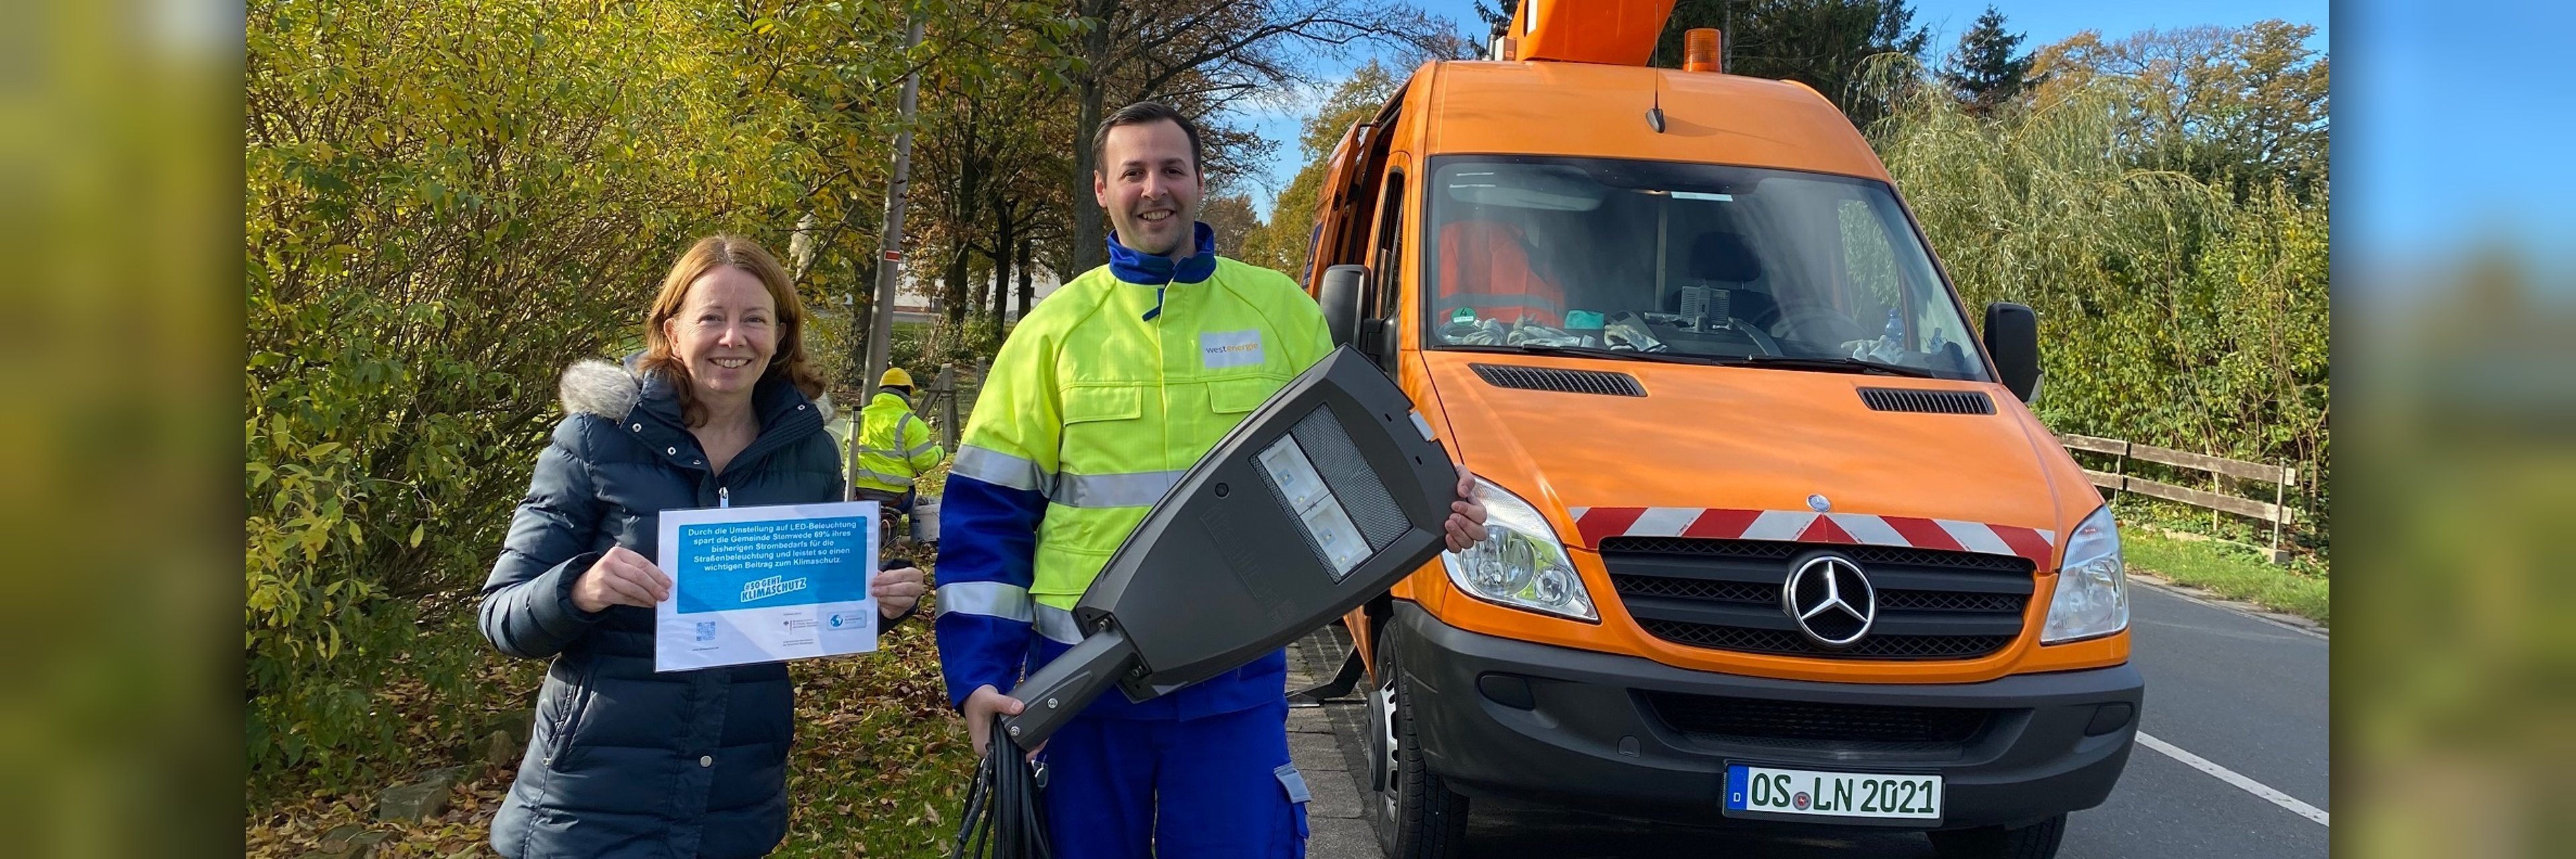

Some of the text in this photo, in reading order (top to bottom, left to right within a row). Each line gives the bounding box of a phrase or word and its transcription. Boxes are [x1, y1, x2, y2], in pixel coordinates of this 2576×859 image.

[1205, 342, 1258, 353] westenergie
[688, 528, 712, 536] Durch
[790, 522, 857, 530] LED-Beleuchtung
[694, 537, 714, 546] spart
[731, 534, 771, 542] Gemeinde
[773, 532, 812, 540] Stemwede
[711, 545, 753, 553] bisherigen
[755, 541, 808, 550] Strombedarfs
[694, 553, 774, 563] Straßenbeleuchtung
[704, 563, 743, 571] wichtigen
[794, 557, 842, 565] Klimaschutz.
[742, 579, 806, 602] KLIMASCHUTZ
[745, 577, 781, 590] #SO GEHT
[1733, 772, 1934, 813] D OS LN 2021
